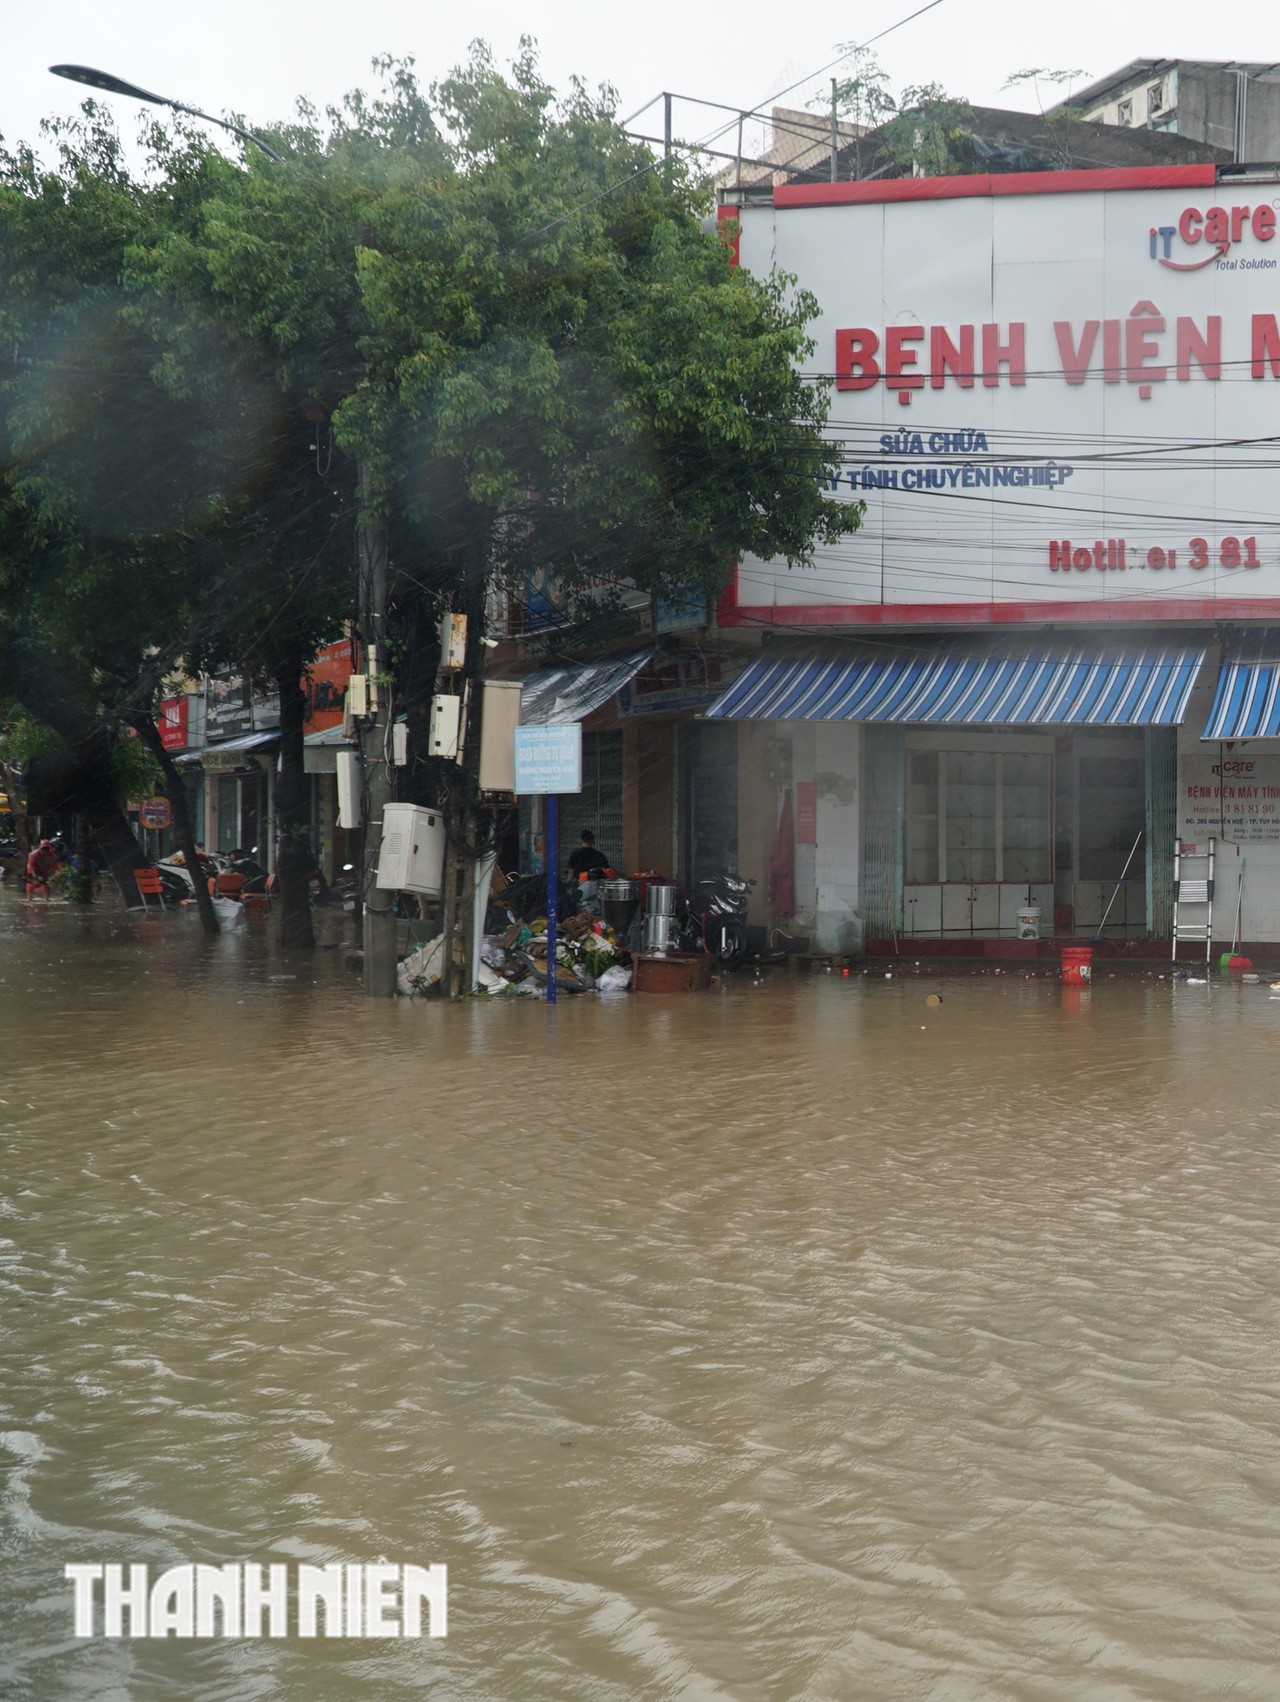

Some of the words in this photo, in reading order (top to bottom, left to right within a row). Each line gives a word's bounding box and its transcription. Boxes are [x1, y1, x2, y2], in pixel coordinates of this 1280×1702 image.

[1216, 259, 1238, 270] Total
[1239, 258, 1277, 270] Solution
[1053, 300, 1222, 400] VIỆN
[880, 427, 924, 454] SỬA
[929, 427, 989, 453] CHỮA
[847, 465, 897, 491] TÍNH
[901, 463, 991, 489] CHUYÊN
[992, 461, 1074, 490] NGHIỆP
[1188, 537, 1209, 570] 3
[1220, 536, 1260, 568] 81
[1188, 784, 1211, 800] BỆNH
[1237, 785, 1259, 799] MÁY
[1262, 804, 1275, 814] 90
